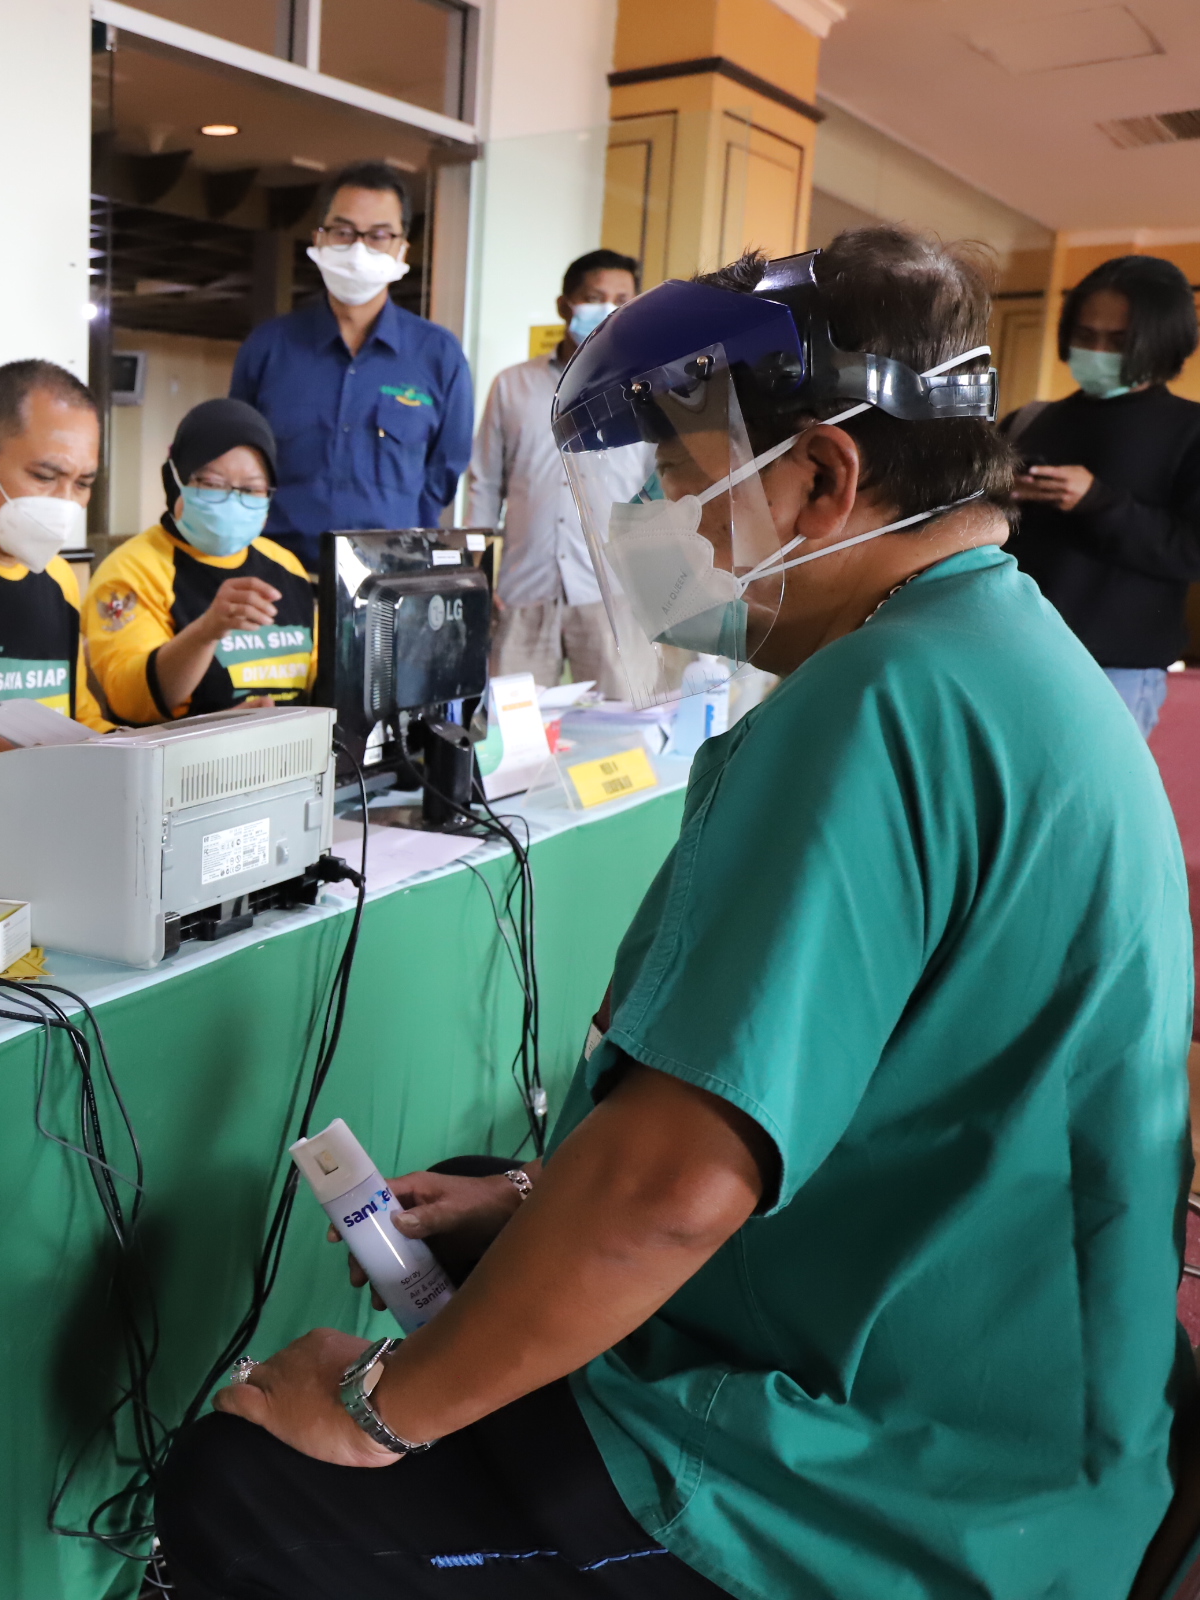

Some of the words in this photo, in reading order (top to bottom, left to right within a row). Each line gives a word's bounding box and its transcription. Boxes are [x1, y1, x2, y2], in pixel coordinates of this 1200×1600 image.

[446, 598, 463, 621] LG
[221, 634, 265, 652] SAYA
[267, 630, 305, 649] SIAP
[25, 667, 67, 689] SIAP
[401, 1270, 421, 1286] spray
